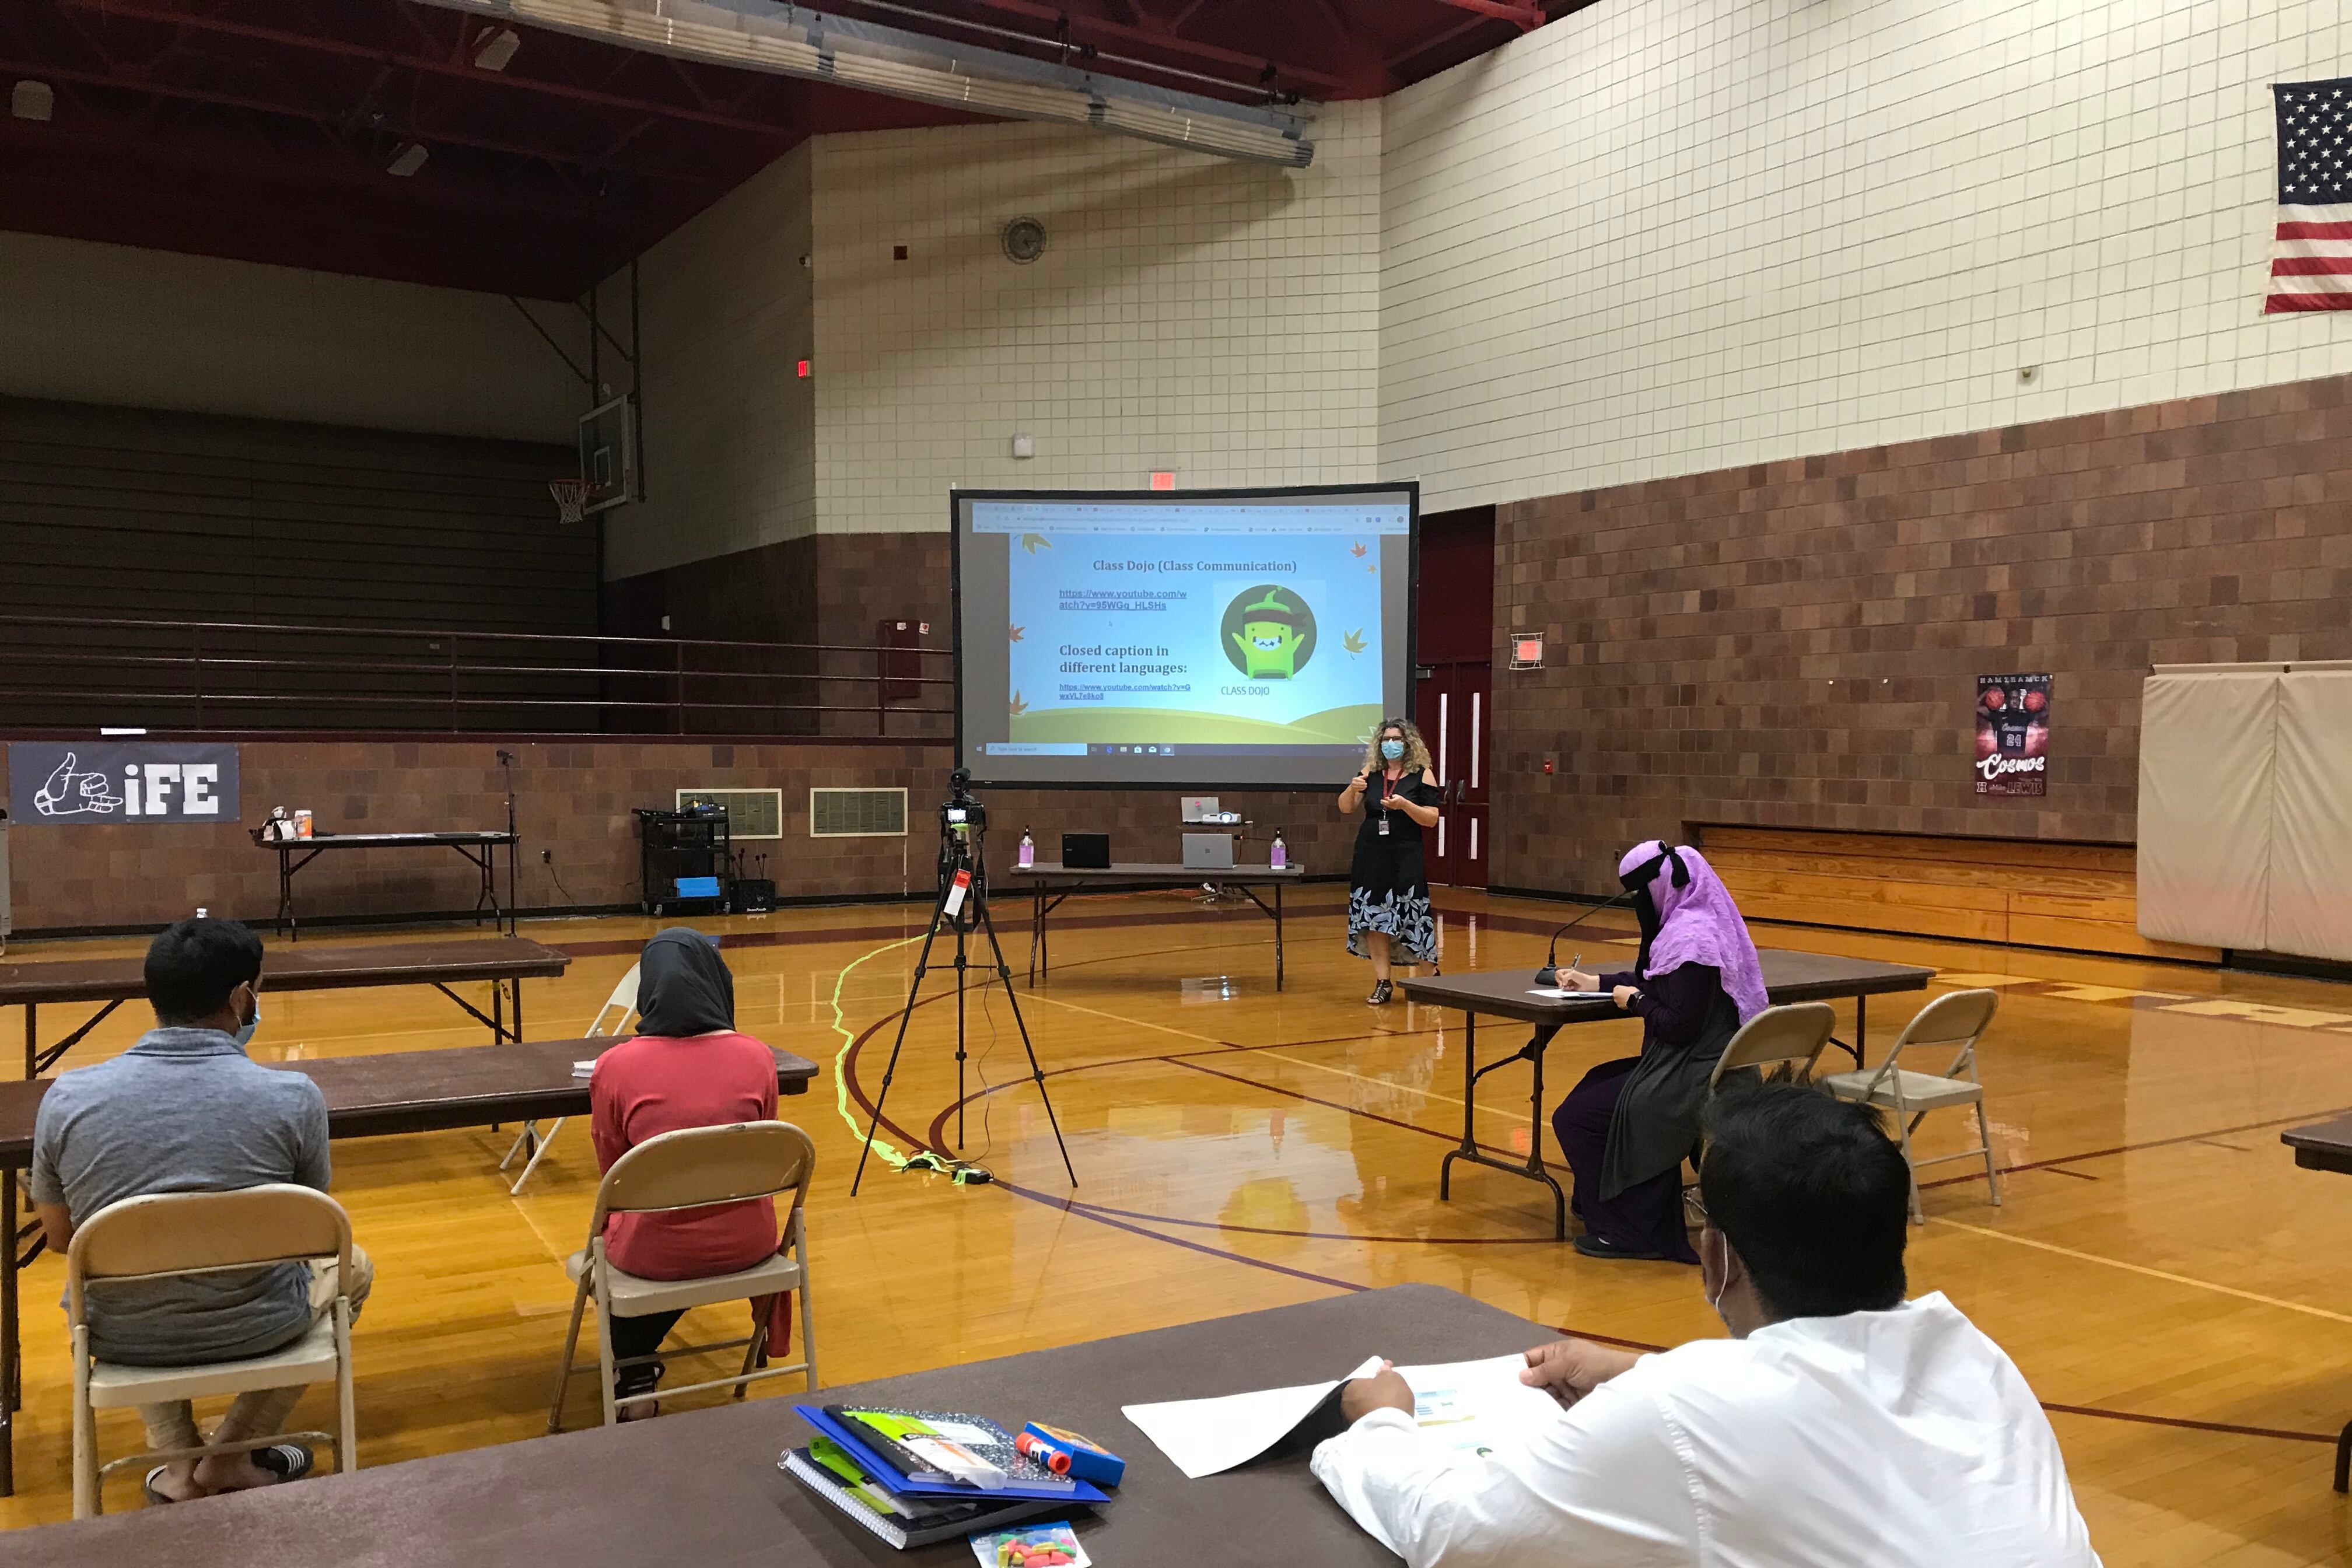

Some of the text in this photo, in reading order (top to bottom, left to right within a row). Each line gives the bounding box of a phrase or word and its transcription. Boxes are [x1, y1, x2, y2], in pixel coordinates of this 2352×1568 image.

[1093, 560, 1297, 573] Class Dojo (Class Communication)
[1059, 589, 1188, 599] https://www.youtube.com/w
[1059, 645, 1169, 659] Closed caption in
[1059, 662, 1188, 676] different languages:
[1221, 686, 1270, 696] CLASS DOJO
[2006, 733, 2022, 747] 24
